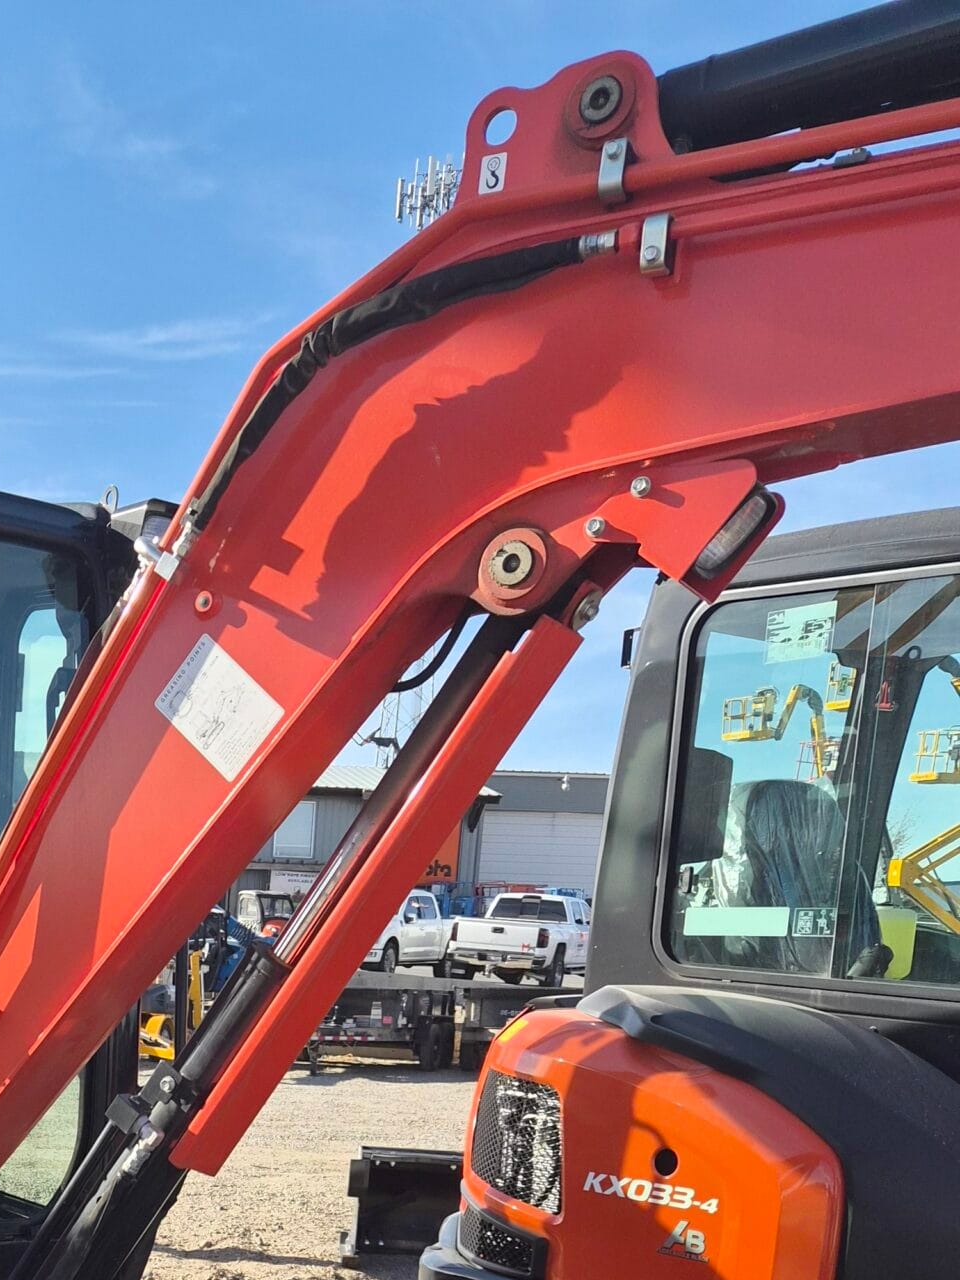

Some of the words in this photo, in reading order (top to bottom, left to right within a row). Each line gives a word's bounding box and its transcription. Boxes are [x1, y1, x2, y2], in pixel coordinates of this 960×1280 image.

[161, 669, 186, 703] GREASING
[187, 641, 206, 666] POINTS
[583, 1171, 720, 1214] KX033-4
[662, 1220, 706, 1254] AB
